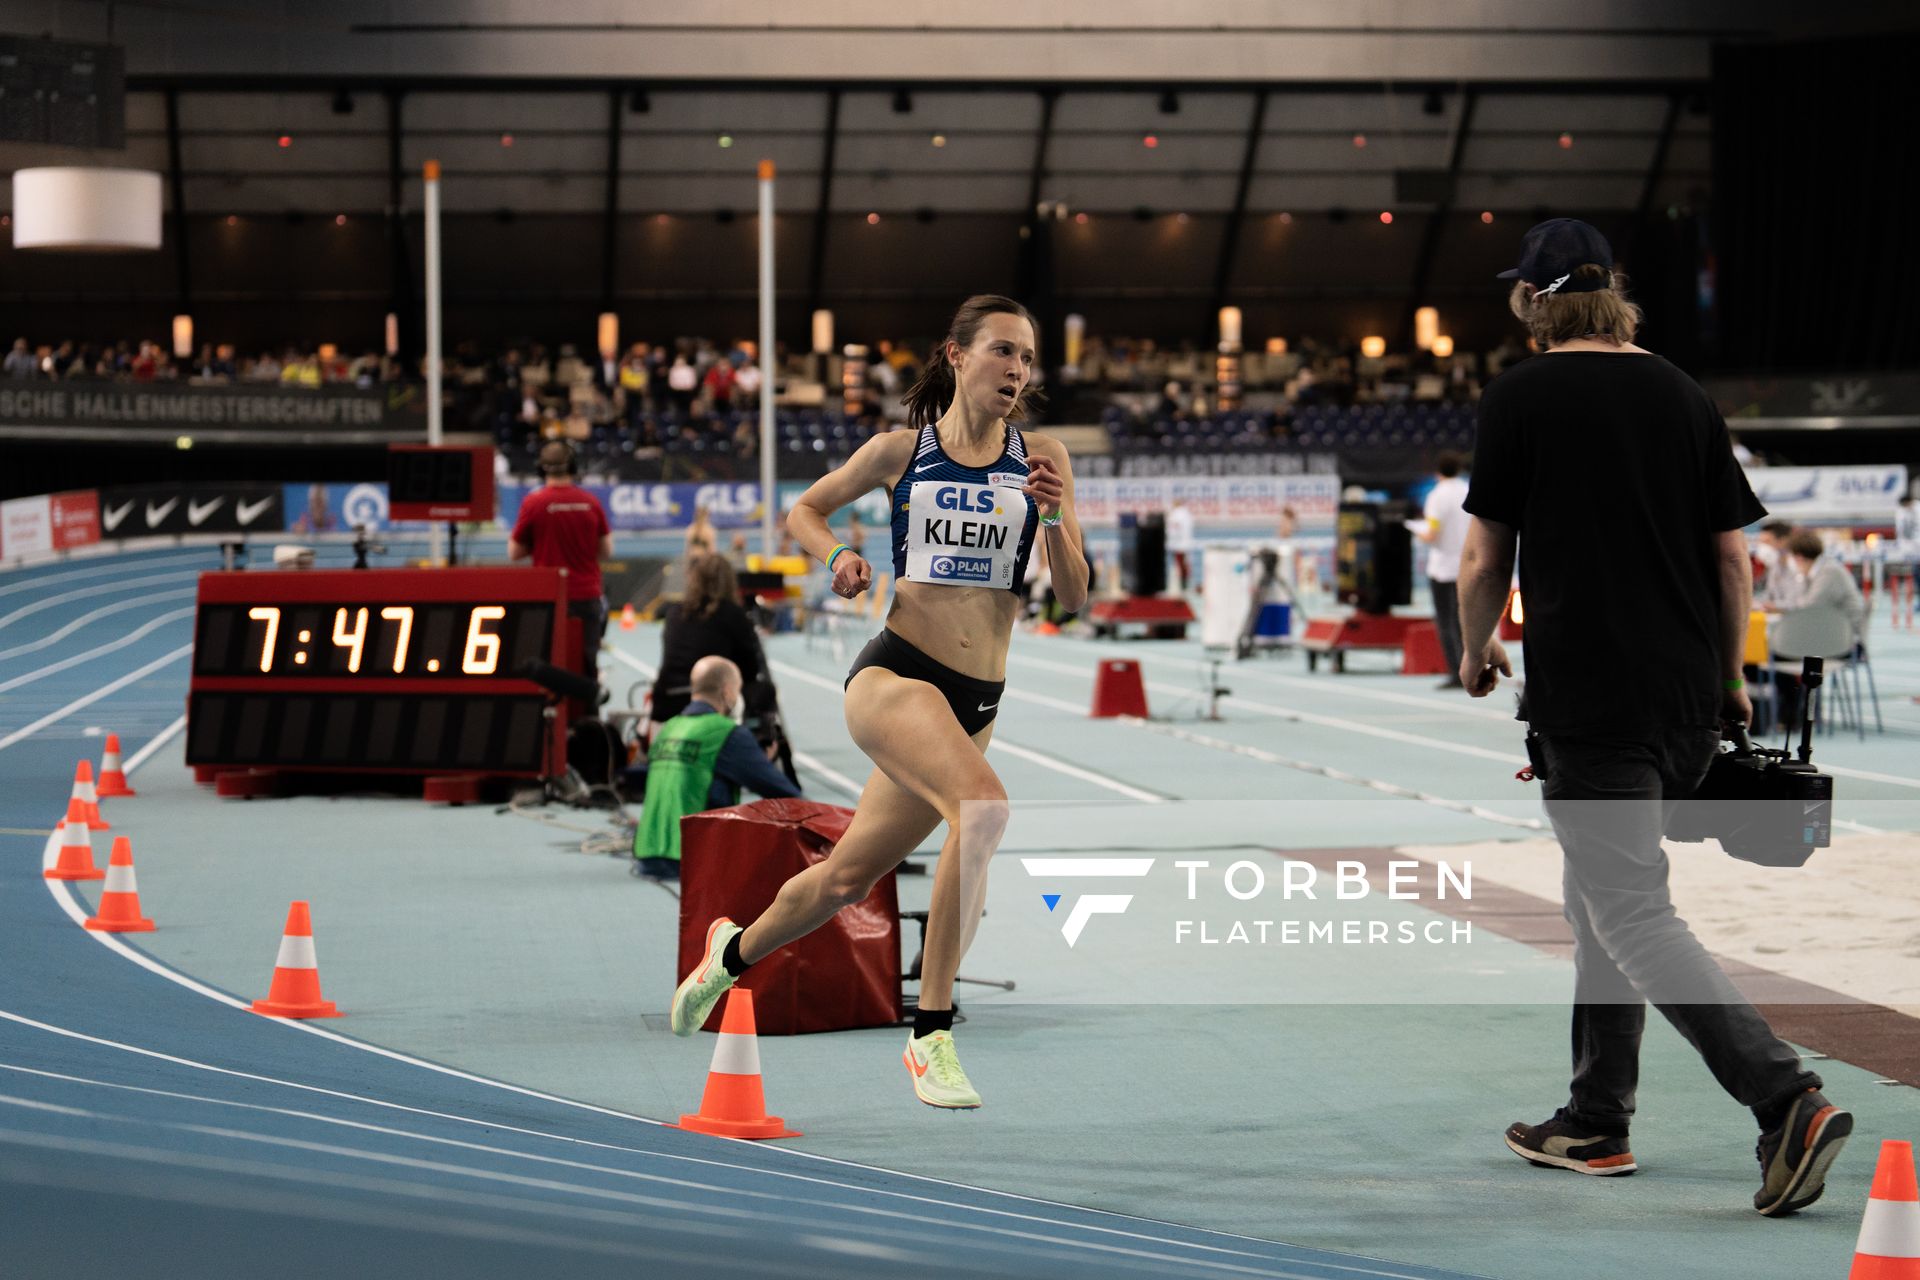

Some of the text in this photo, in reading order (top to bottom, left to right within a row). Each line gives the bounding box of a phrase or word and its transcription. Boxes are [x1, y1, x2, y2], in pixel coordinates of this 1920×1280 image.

[74, 394, 382, 424] HALLENMEISTERSCHAFTEN
[925, 518, 1008, 550] KLEIN
[957, 560, 989, 573] PLAN
[1002, 563, 1010, 579] 385
